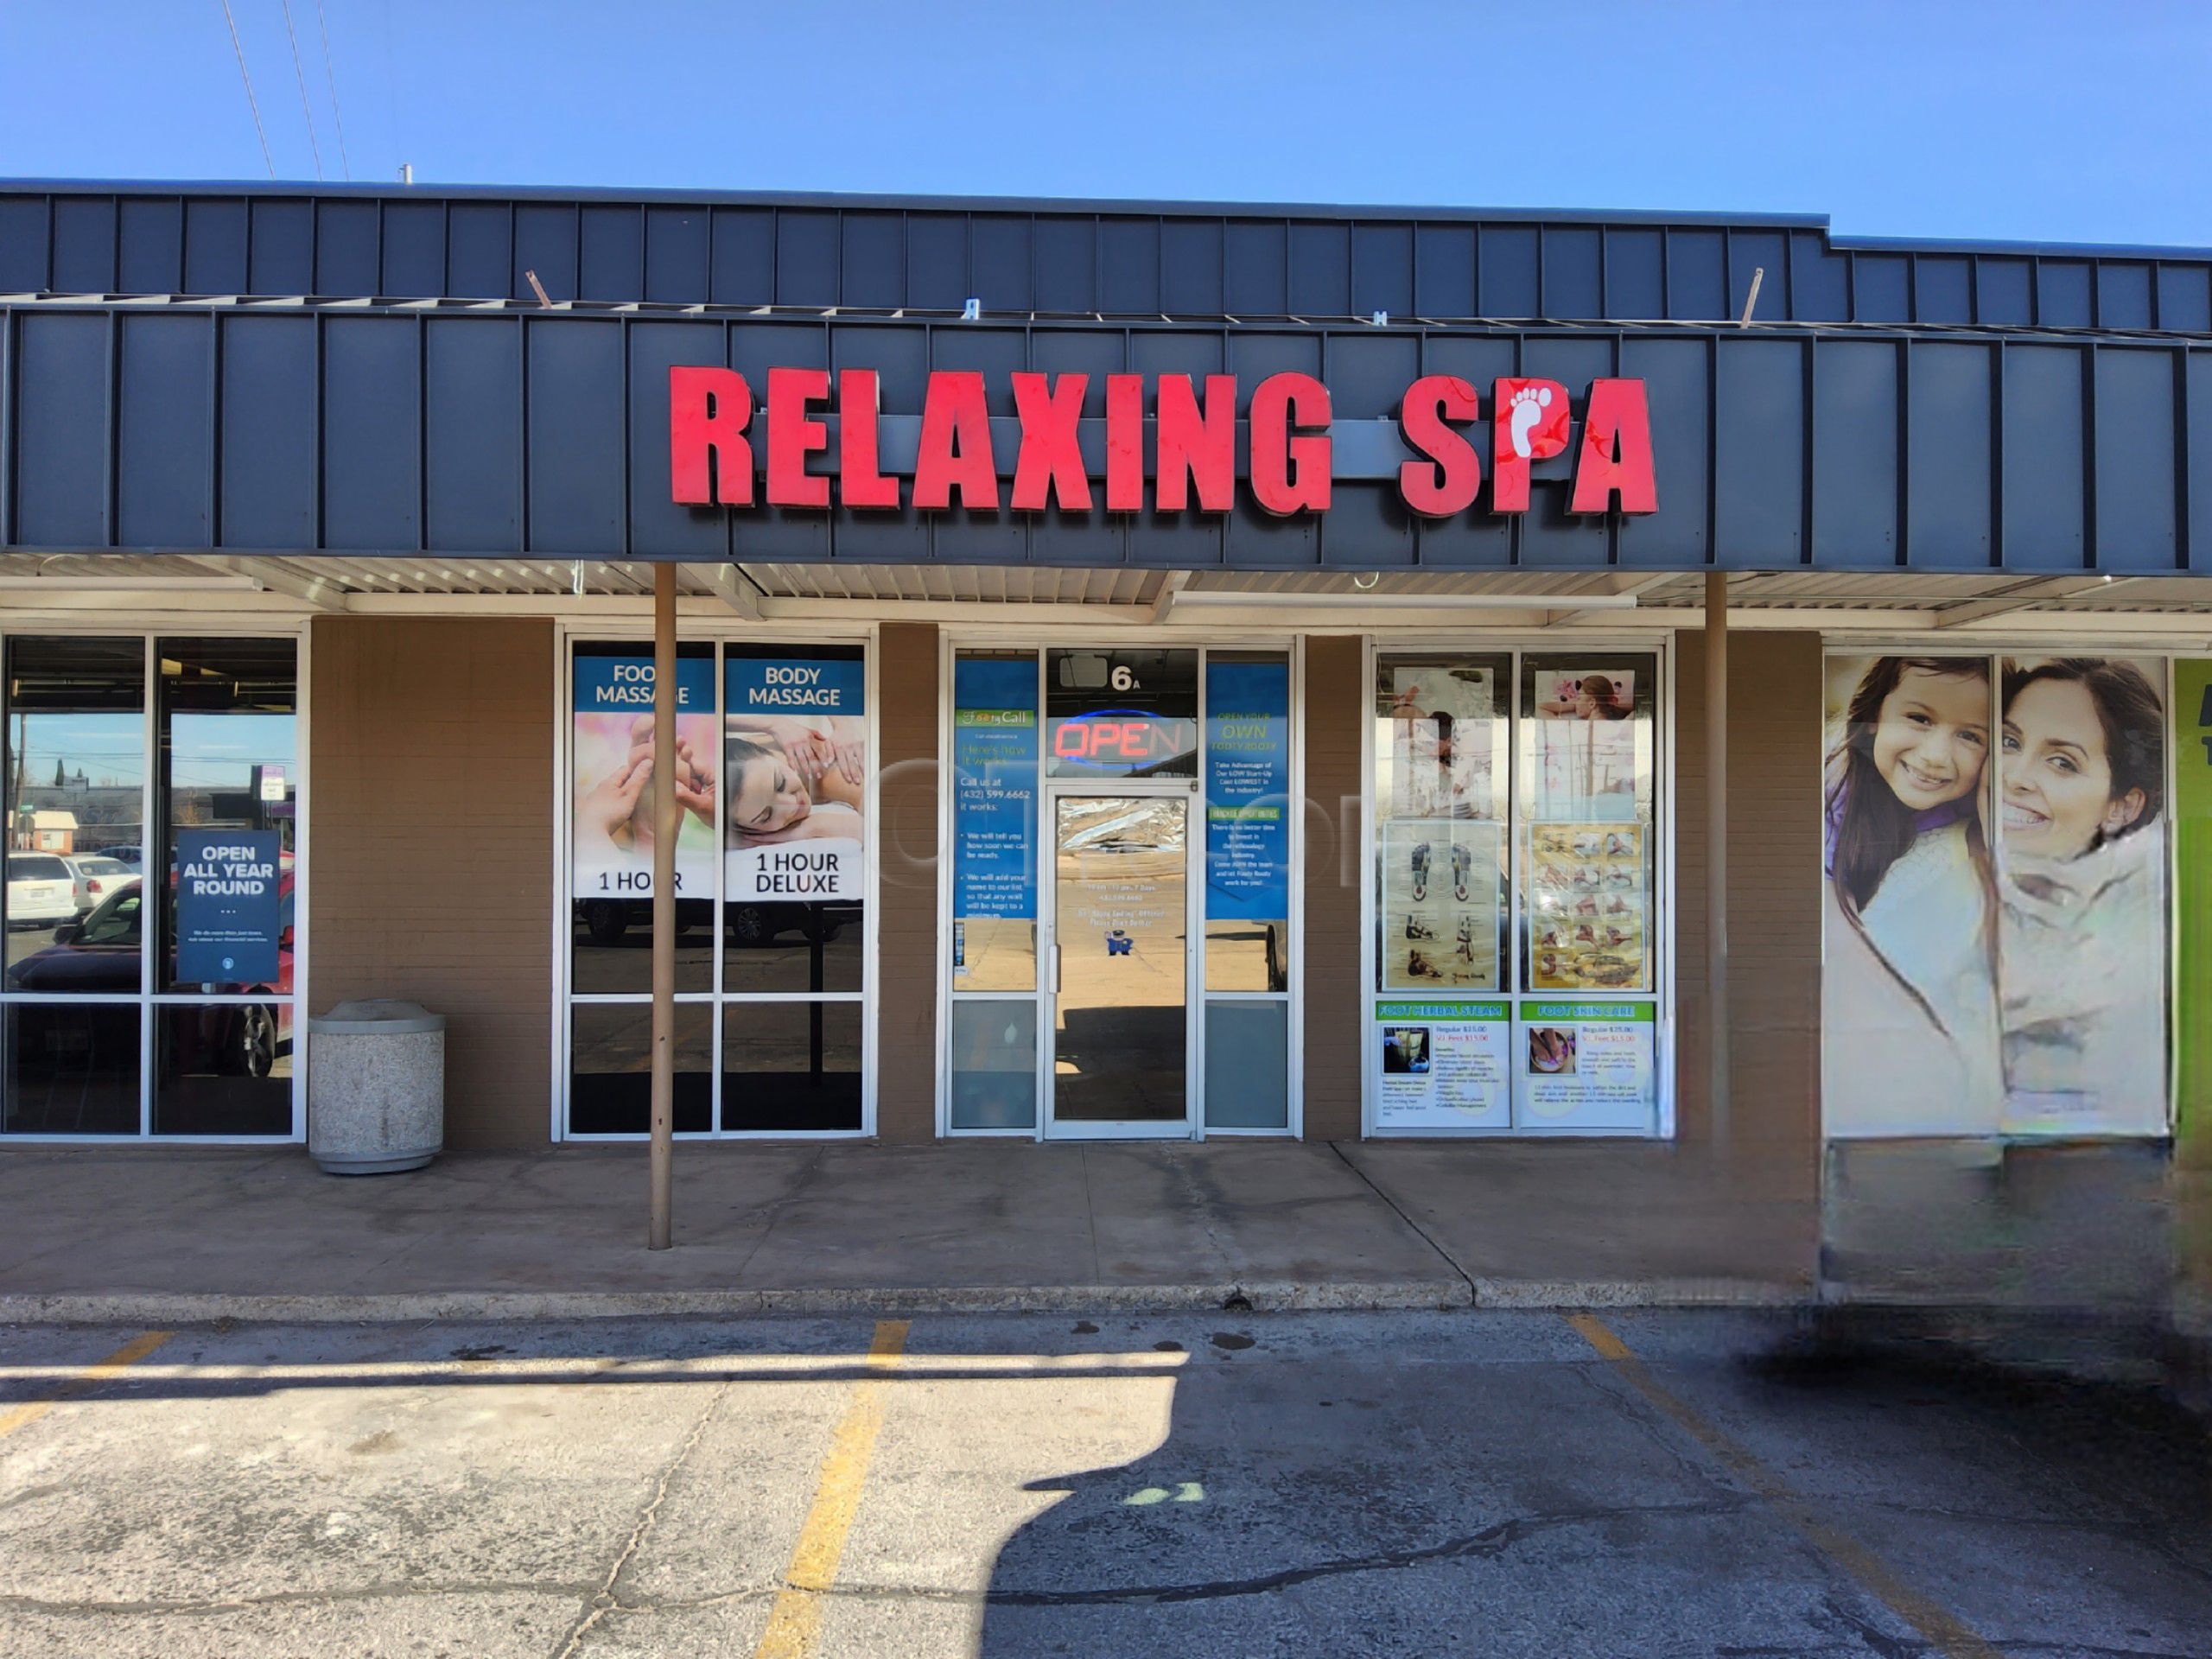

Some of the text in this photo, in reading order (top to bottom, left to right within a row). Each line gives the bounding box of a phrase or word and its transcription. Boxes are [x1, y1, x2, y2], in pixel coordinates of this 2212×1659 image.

[669, 365, 1660, 516] RELAXING SPA
[613, 665, 655, 682] FOO
[766, 667, 820, 685] BODY
[749, 688, 840, 706] MASSAGE
[1054, 723, 1181, 757] OPEN
[1221, 724, 1267, 739] OWN
[960, 778, 977, 786] Call
[201, 846, 256, 861] OPEN
[183, 863, 273, 878] ALL YEAR
[757, 854, 838, 871] 1 HOUR
[194, 880, 265, 895] ROUND
[600, 873, 609, 890] 1
[756, 874, 839, 893] DELUXE
[1378, 1005, 1503, 1017] FOOT HERBAL STEAM
[1538, 1005, 1636, 1017] FOOT SKIN CARE
